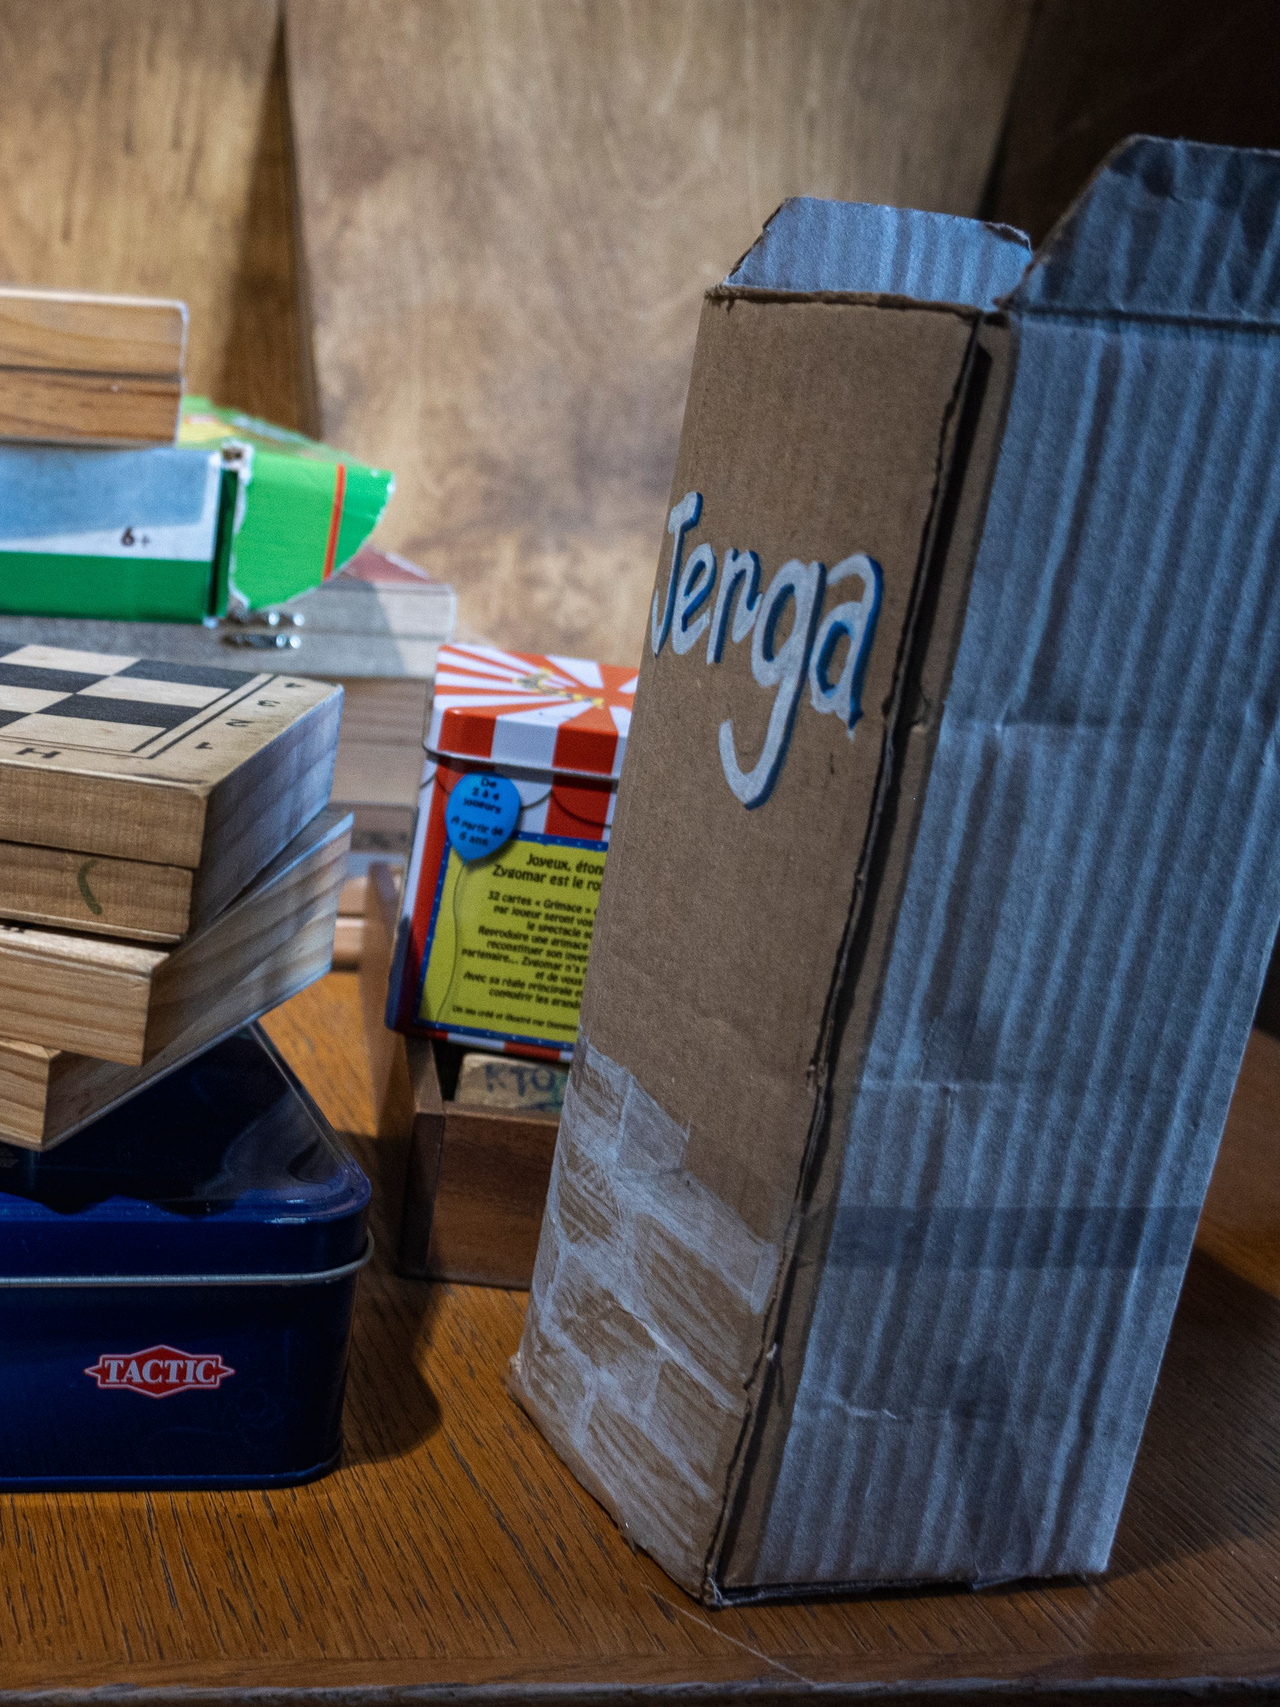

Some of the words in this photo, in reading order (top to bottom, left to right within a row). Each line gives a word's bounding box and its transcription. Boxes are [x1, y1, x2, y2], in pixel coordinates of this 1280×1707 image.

[120, 526, 150, 548] 6+
[651, 491, 884, 811] Jenga
[481, 777, 497, 789] De
[463, 797, 502, 815] joueurs
[461, 821, 489, 833] partir
[492, 863, 547, 884] Zygomar
[549, 875, 570, 888] est
[572, 876, 584, 889] le
[575, 860, 604, 876] éton
[502, 894, 532, 906] cartes
[543, 899, 582, 914] Grimace
[104, 1358, 217, 1384] TACTIC
